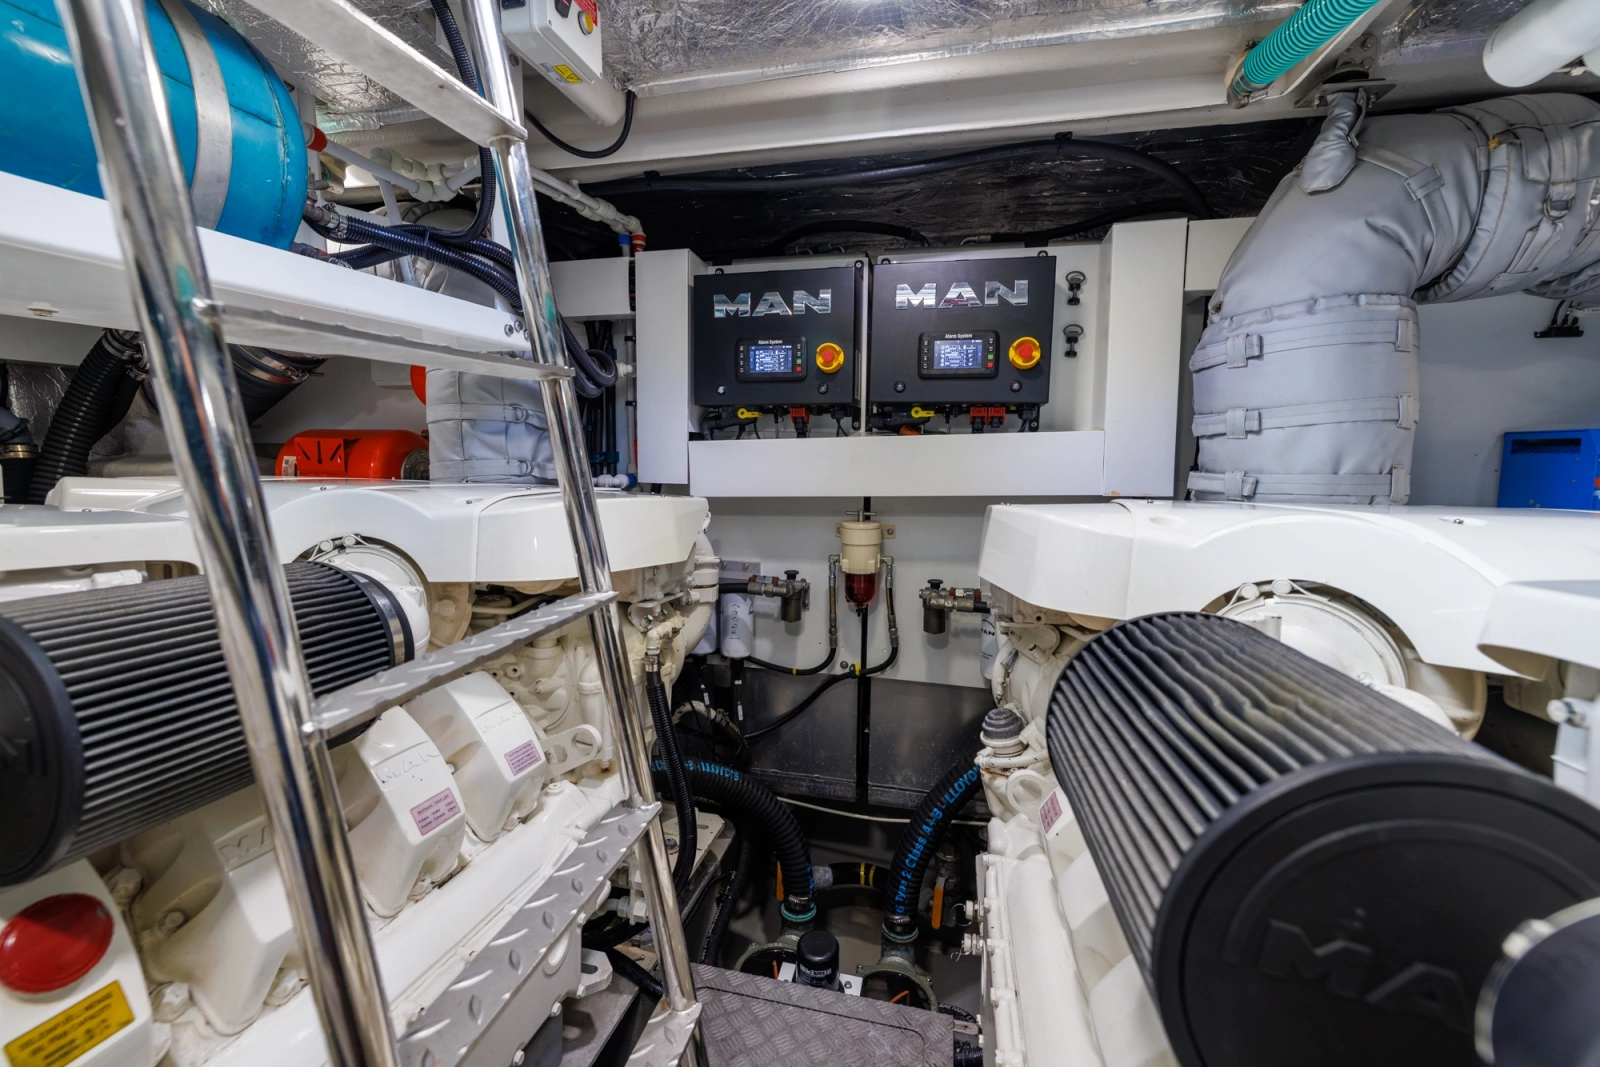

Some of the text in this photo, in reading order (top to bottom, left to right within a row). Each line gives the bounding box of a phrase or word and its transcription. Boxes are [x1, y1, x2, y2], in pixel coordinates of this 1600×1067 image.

[714, 289, 831, 317] MAN
[896, 280, 1028, 309] MAN
[701, 761, 740, 781] LLOYD'S
[943, 765, 980, 804] LLOYD'
[922, 807, 944, 836] A+B
[905, 836, 927, 869] Class
[901, 870, 913, 880] 2
[895, 878, 908, 901] Type
